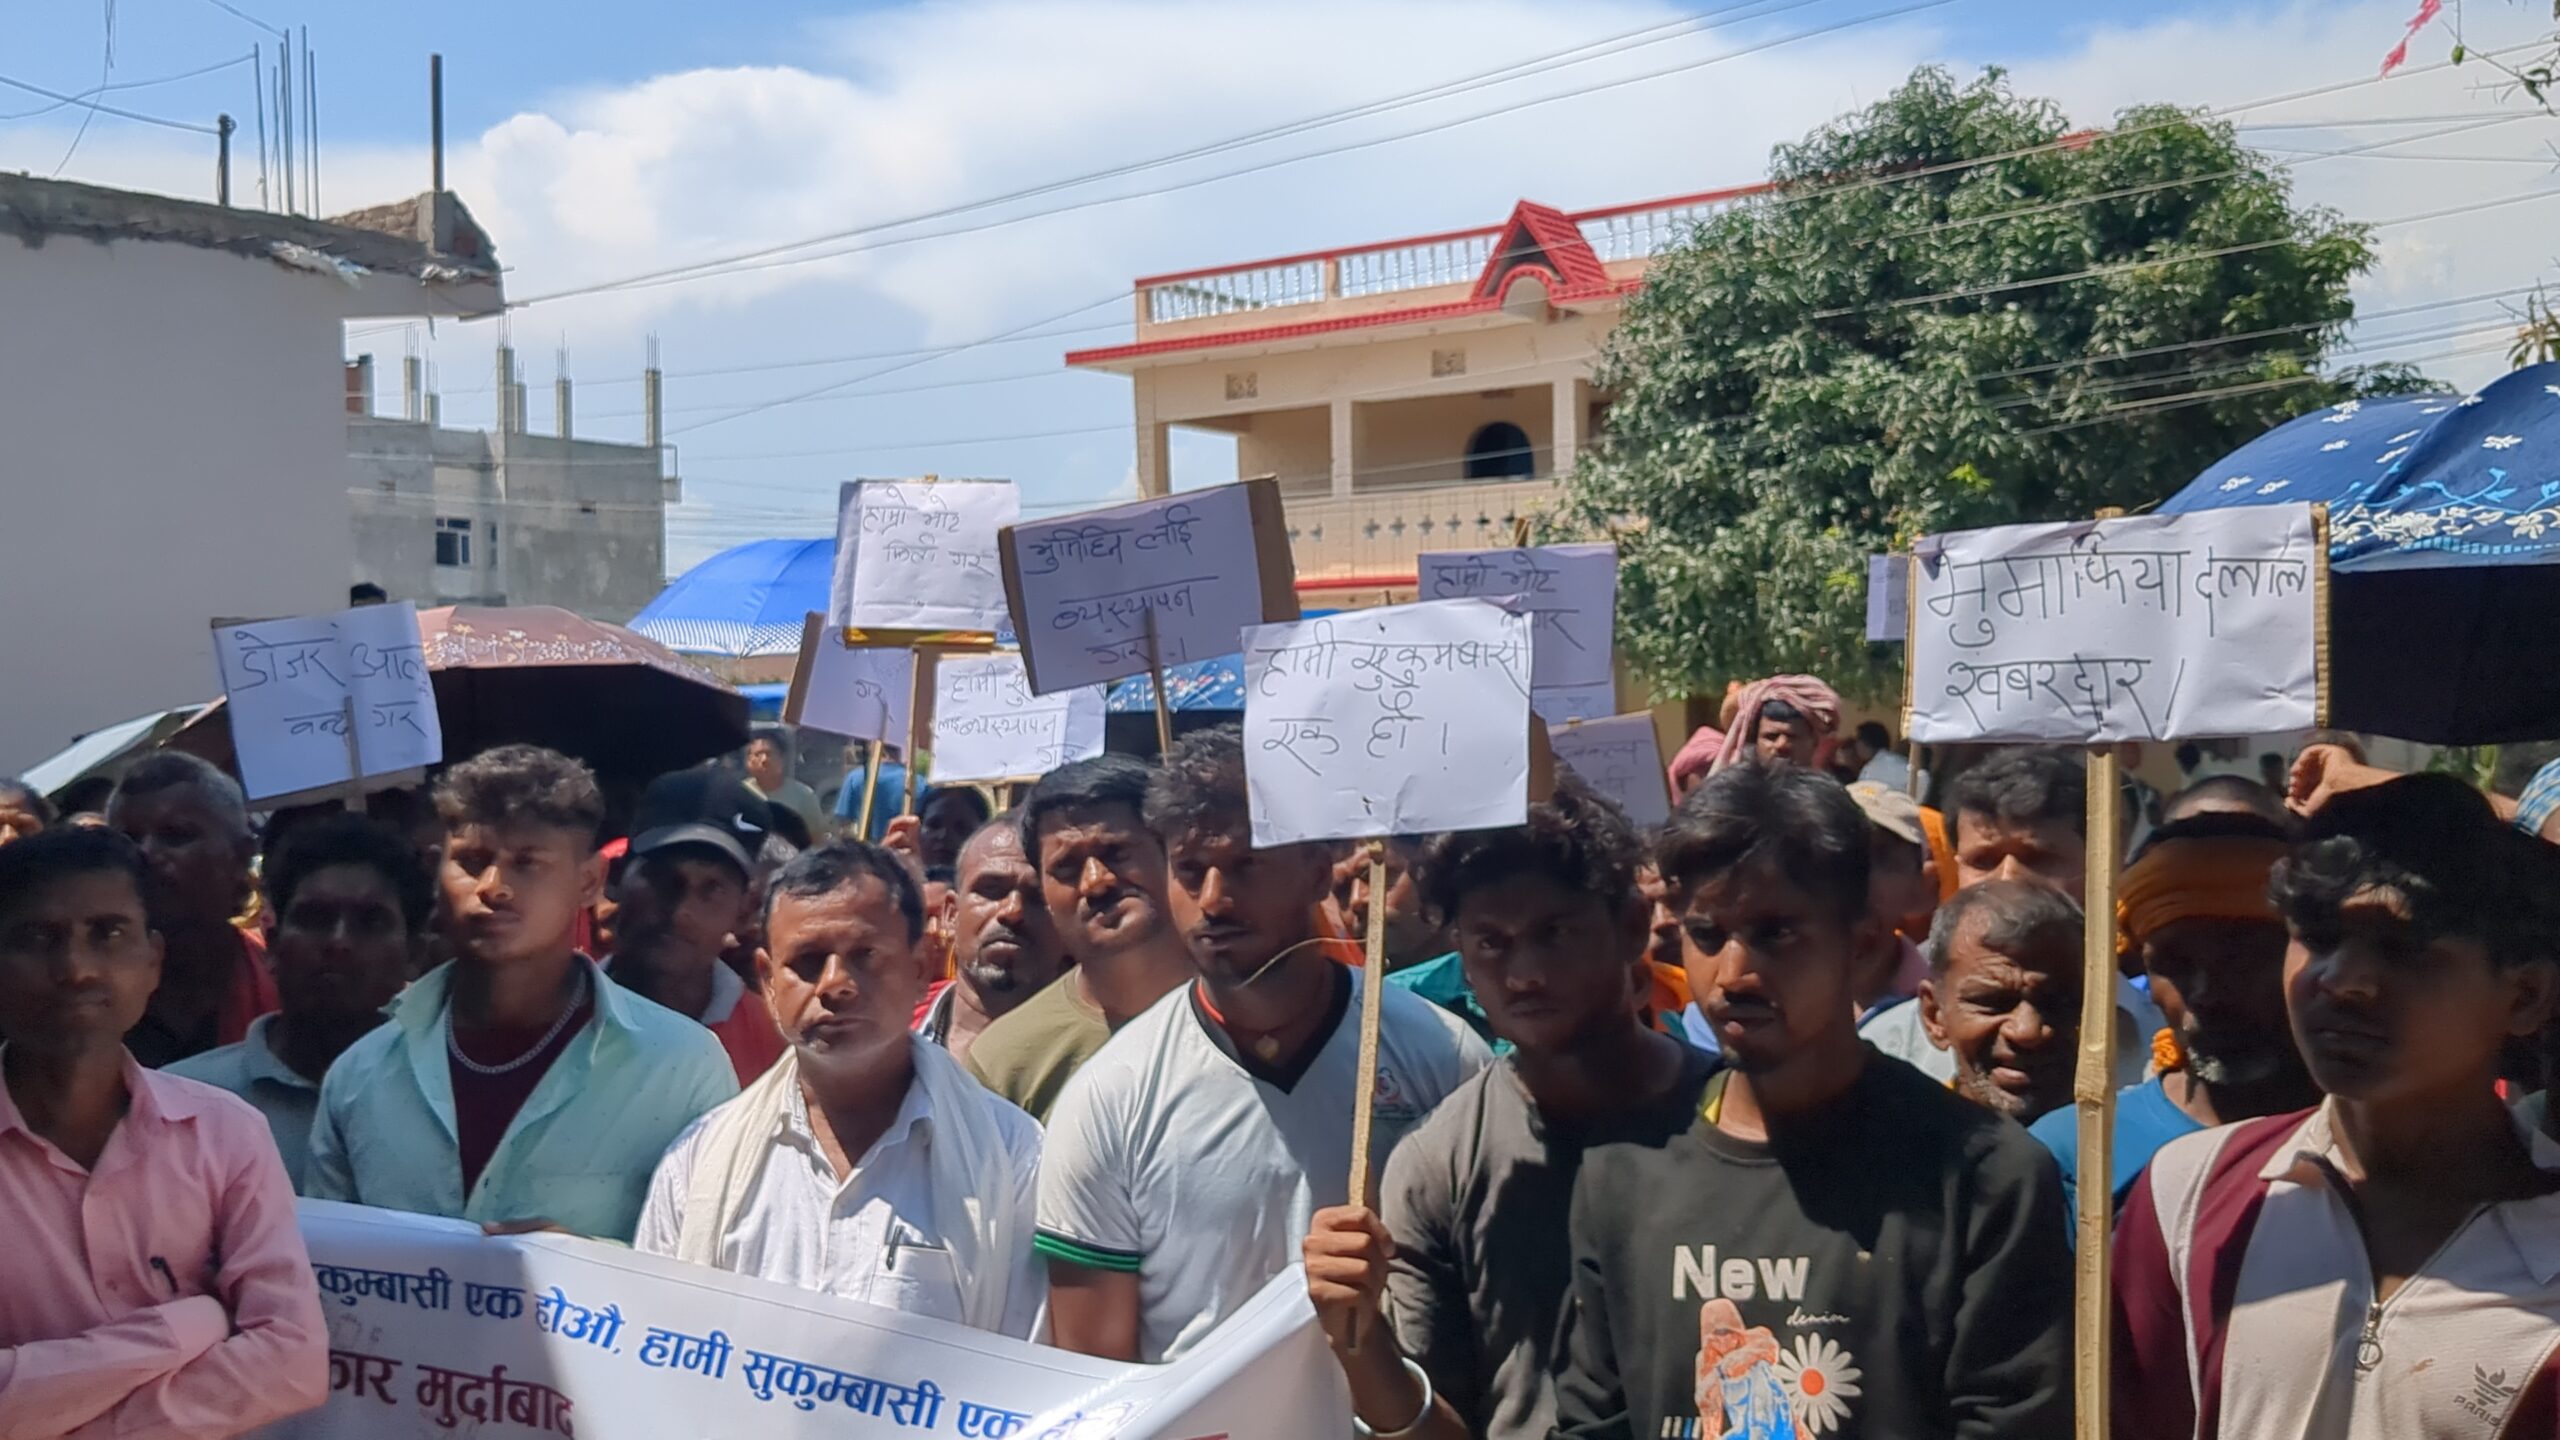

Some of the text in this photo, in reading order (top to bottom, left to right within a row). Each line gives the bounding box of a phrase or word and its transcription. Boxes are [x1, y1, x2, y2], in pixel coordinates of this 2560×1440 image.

[2195, 546, 2308, 637] दलाल
[1255, 619, 1337, 696] हामी
[372, 700, 428, 738] गर
[1263, 716, 1340, 776] एक
[1672, 1245, 1810, 1300] New
[311, 1263, 453, 1312] कुम्बासी
[464, 1282, 528, 1321] एक
[639, 1327, 734, 1380] हामी
[742, 1349, 946, 1430] सुकुम्बासी
[416, 1365, 575, 1440] मुर्दाबाद
[2453, 1394, 2503, 1428] PARIS
